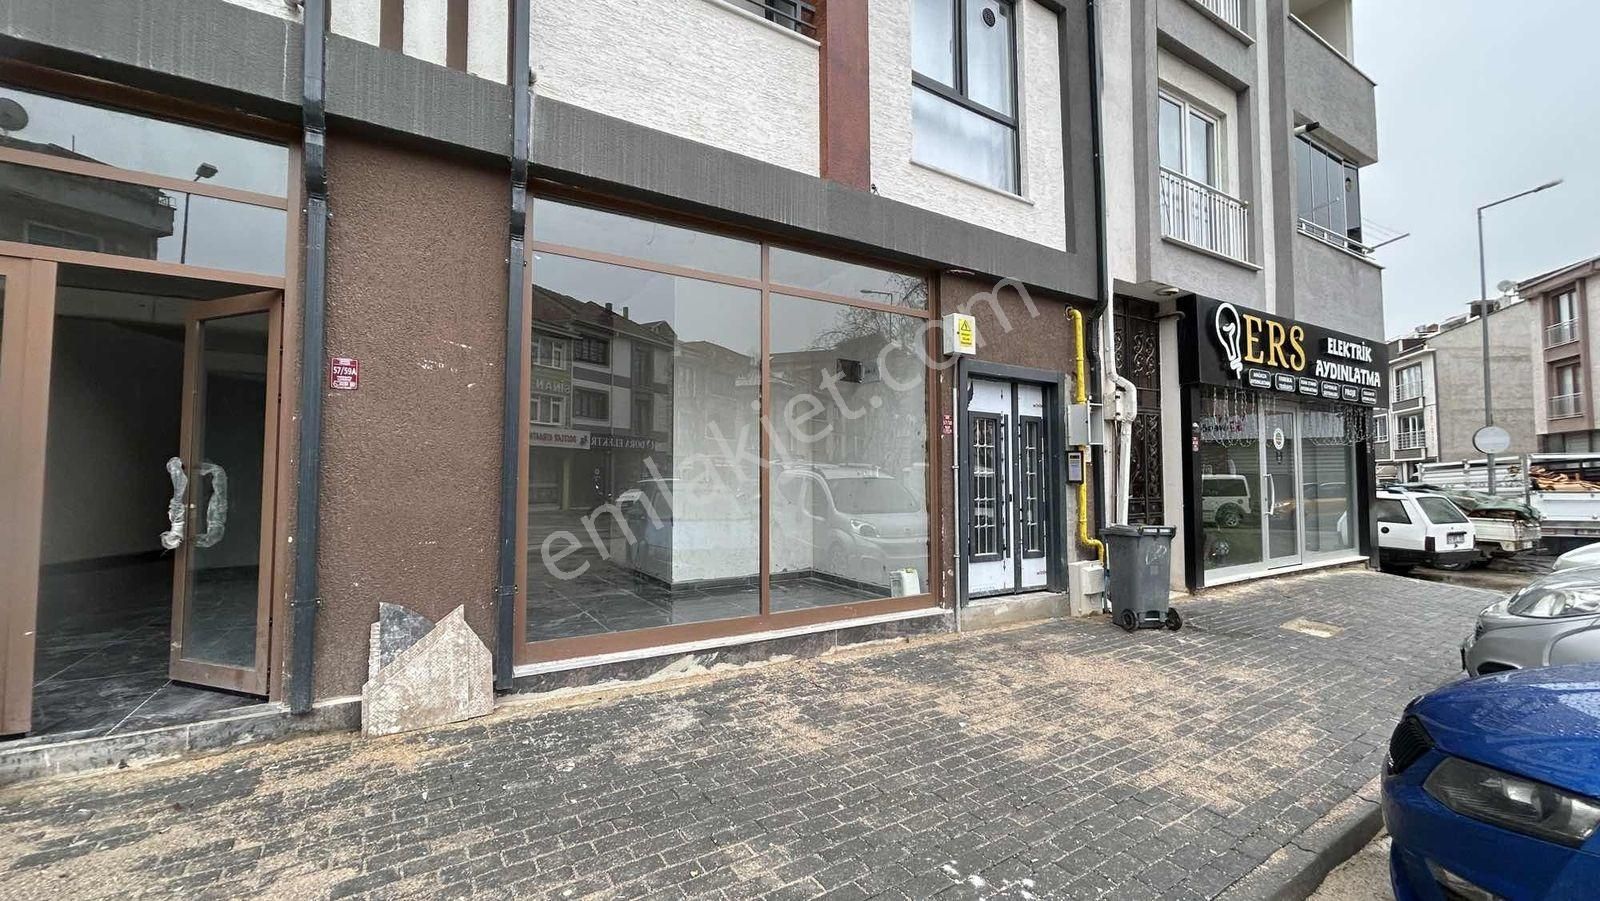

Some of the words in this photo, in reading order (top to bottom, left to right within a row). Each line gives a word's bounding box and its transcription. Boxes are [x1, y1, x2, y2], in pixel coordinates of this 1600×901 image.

[1243, 313, 1306, 371] ERS
[1327, 337, 1373, 363] ELEKTRİK
[333, 366, 357, 376] 57/59A
[1315, 360, 1381, 388] AYDINLATMA
